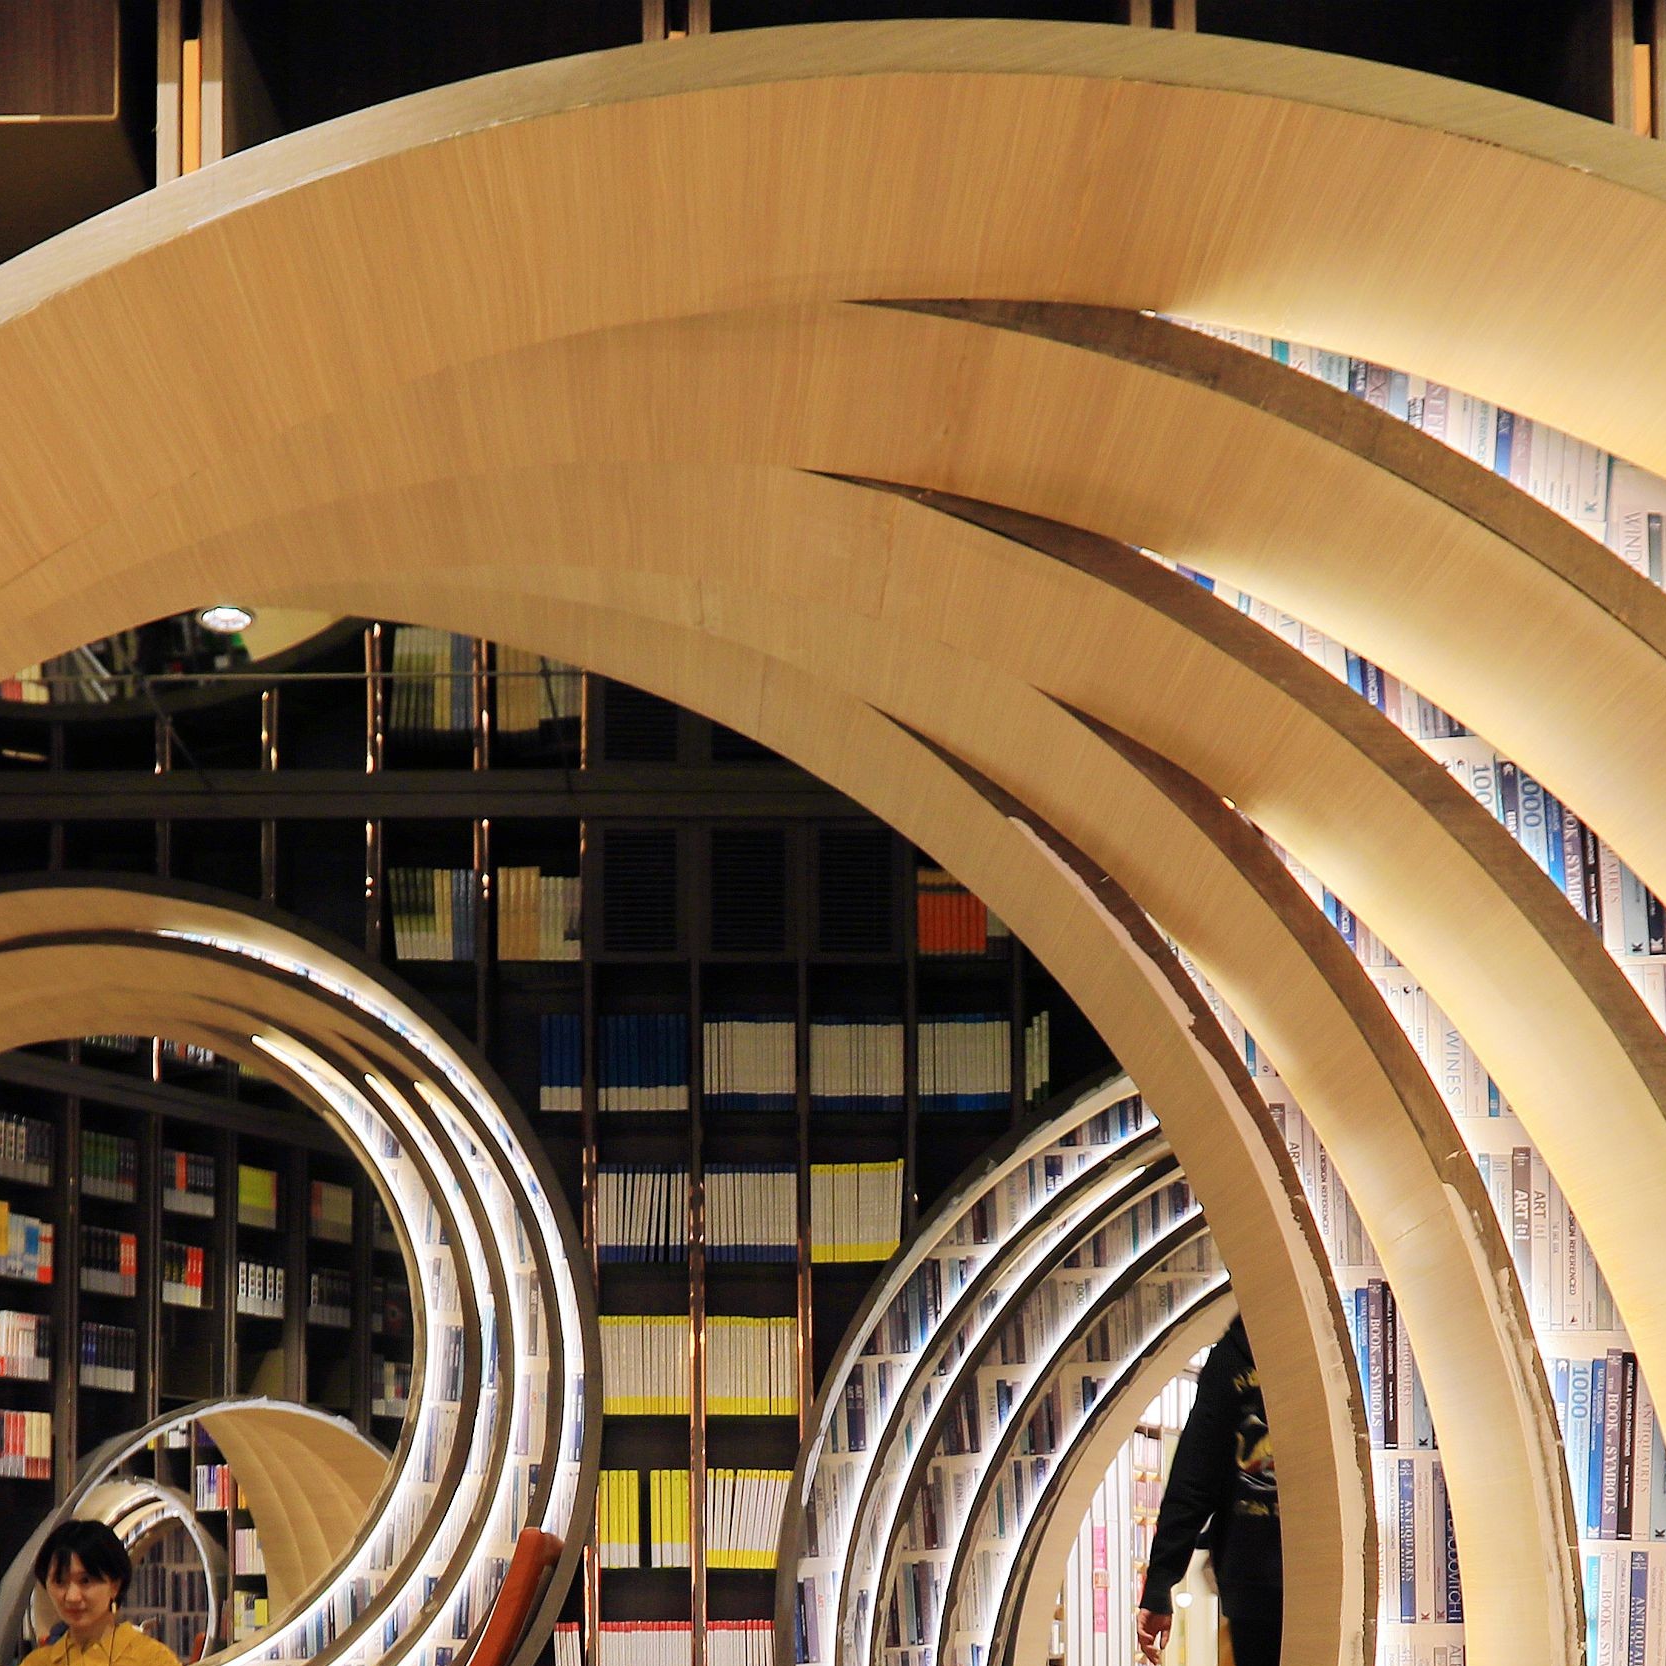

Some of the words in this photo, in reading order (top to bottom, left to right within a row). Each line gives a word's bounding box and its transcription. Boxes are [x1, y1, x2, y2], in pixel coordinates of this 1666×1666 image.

[1572, 1366, 1589, 1419] 1000
[1609, 1391, 1620, 1430] BOOK
[1603, 1441, 1619, 1515] SYMBOLS
